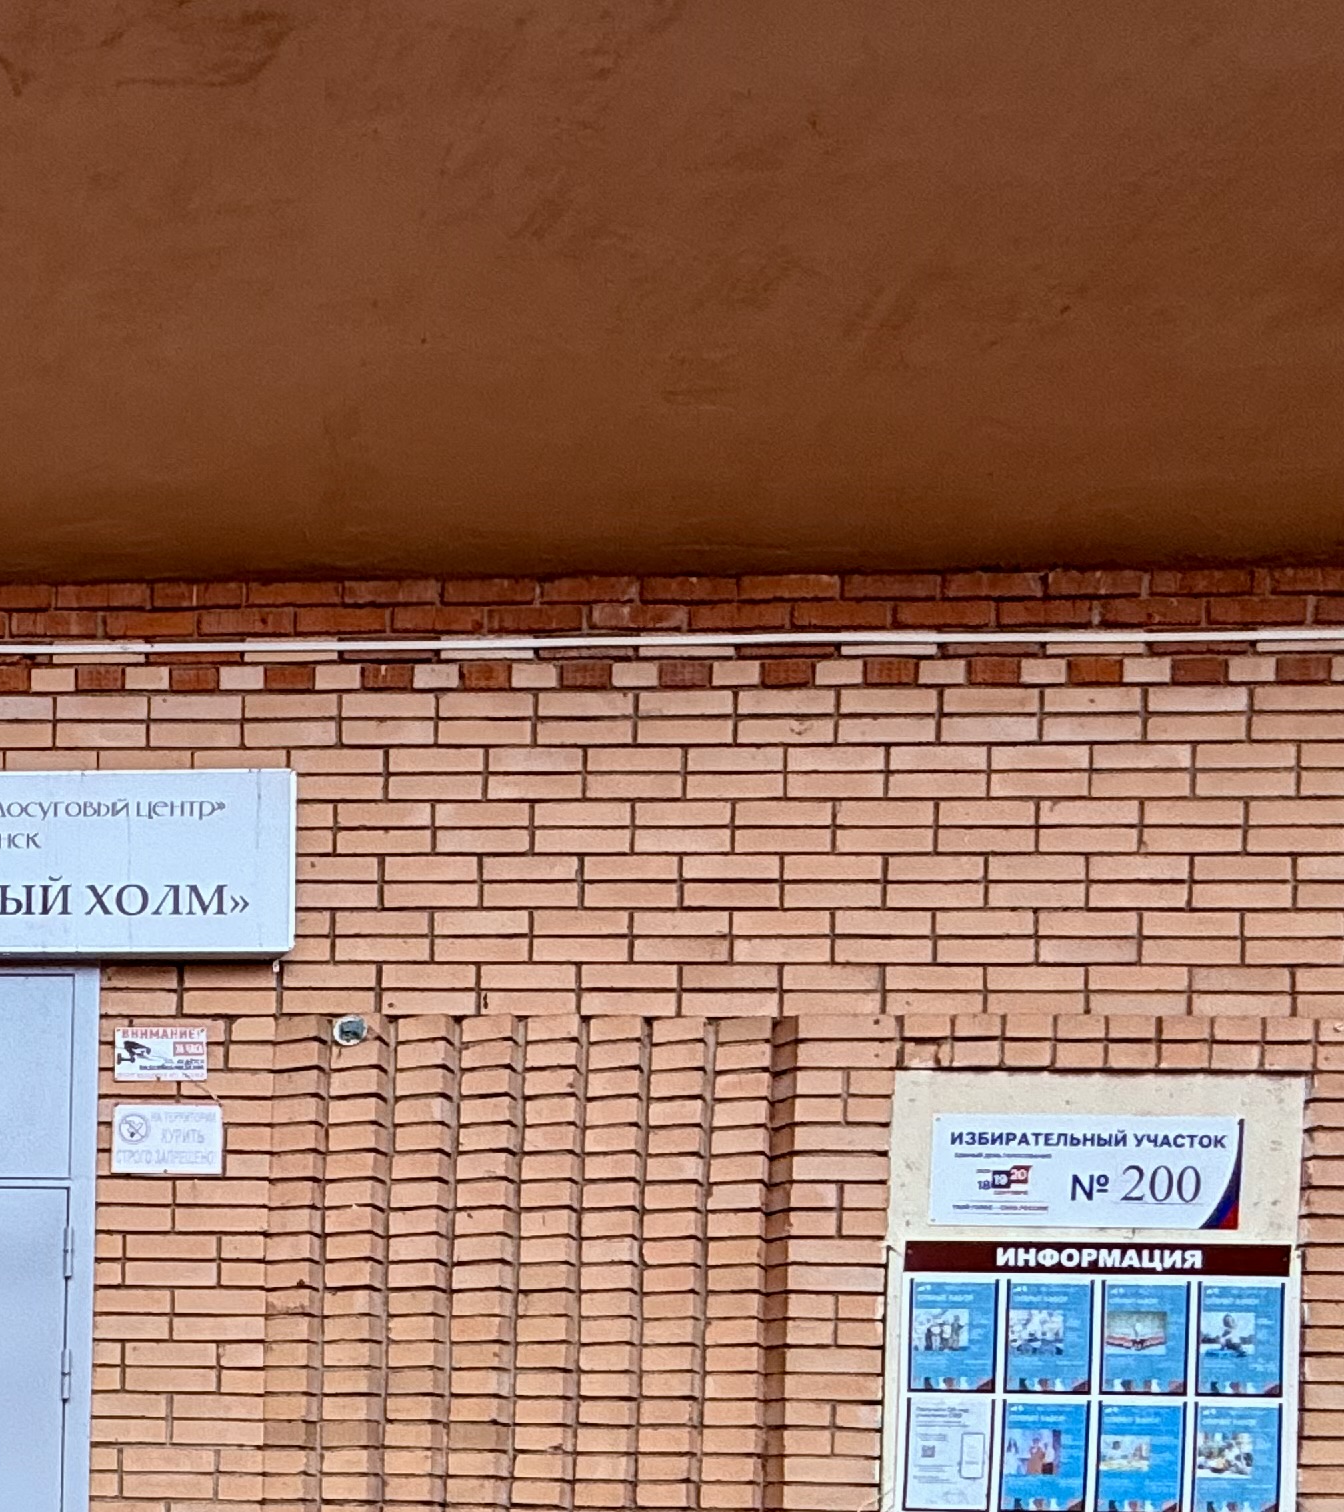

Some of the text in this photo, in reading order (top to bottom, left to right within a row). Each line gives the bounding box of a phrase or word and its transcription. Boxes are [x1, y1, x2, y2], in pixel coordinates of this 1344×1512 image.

[135, 799, 227, 820] центр»
[84, 884, 250, 917] ХОЛМ»
[121, 1028, 200, 1040] ВНИМАНИЕ!
[161, 1128, 205, 1144] КУРИТЬ
[949, 1129, 1228, 1149] ИЗБИРАТЕЛЬНЫЙ УЧАСТОК
[1010, 1169, 1027, 1179] 20
[1070, 1164, 1202, 1202] № 200
[996, 1246, 1203, 1270] ИНФОРМАЦИЯ
